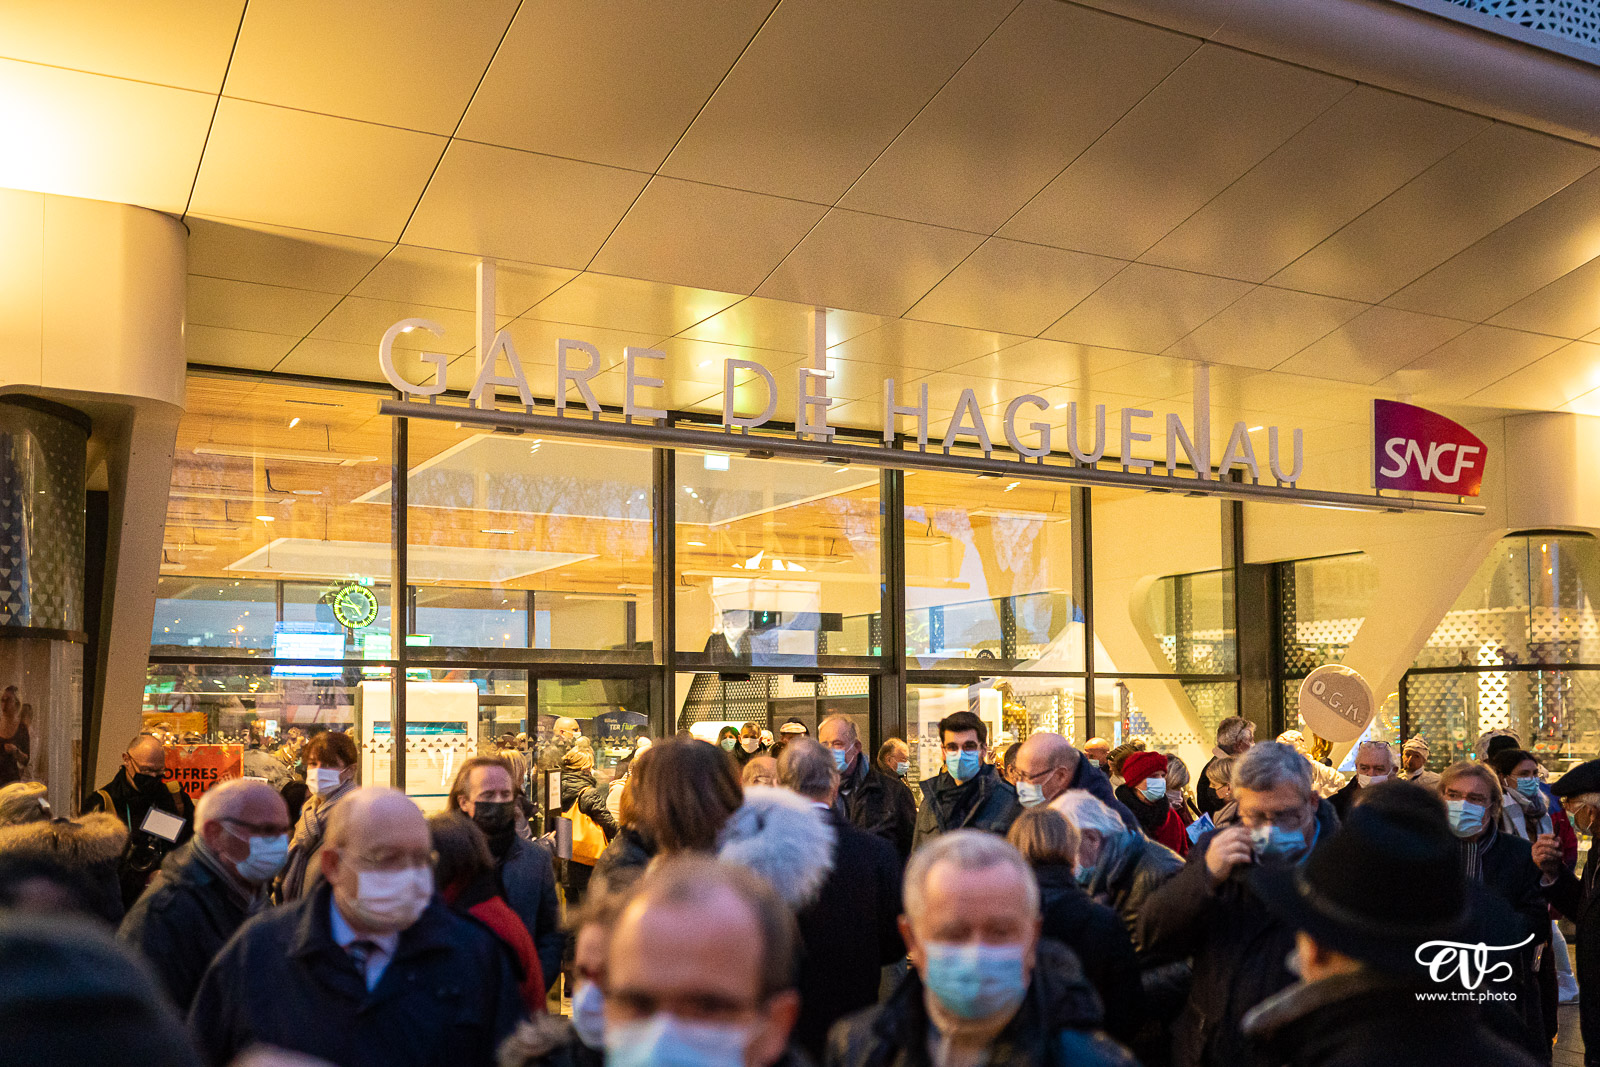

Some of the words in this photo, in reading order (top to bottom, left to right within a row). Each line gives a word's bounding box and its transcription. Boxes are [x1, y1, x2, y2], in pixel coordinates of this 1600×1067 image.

[379, 317, 667, 420] GARE
[722, 358, 836, 435] DE
[883, 378, 1304, 484] HAGUENAU
[1380, 437, 1480, 483] SNCF
[162, 767, 218, 780] OFFRES
